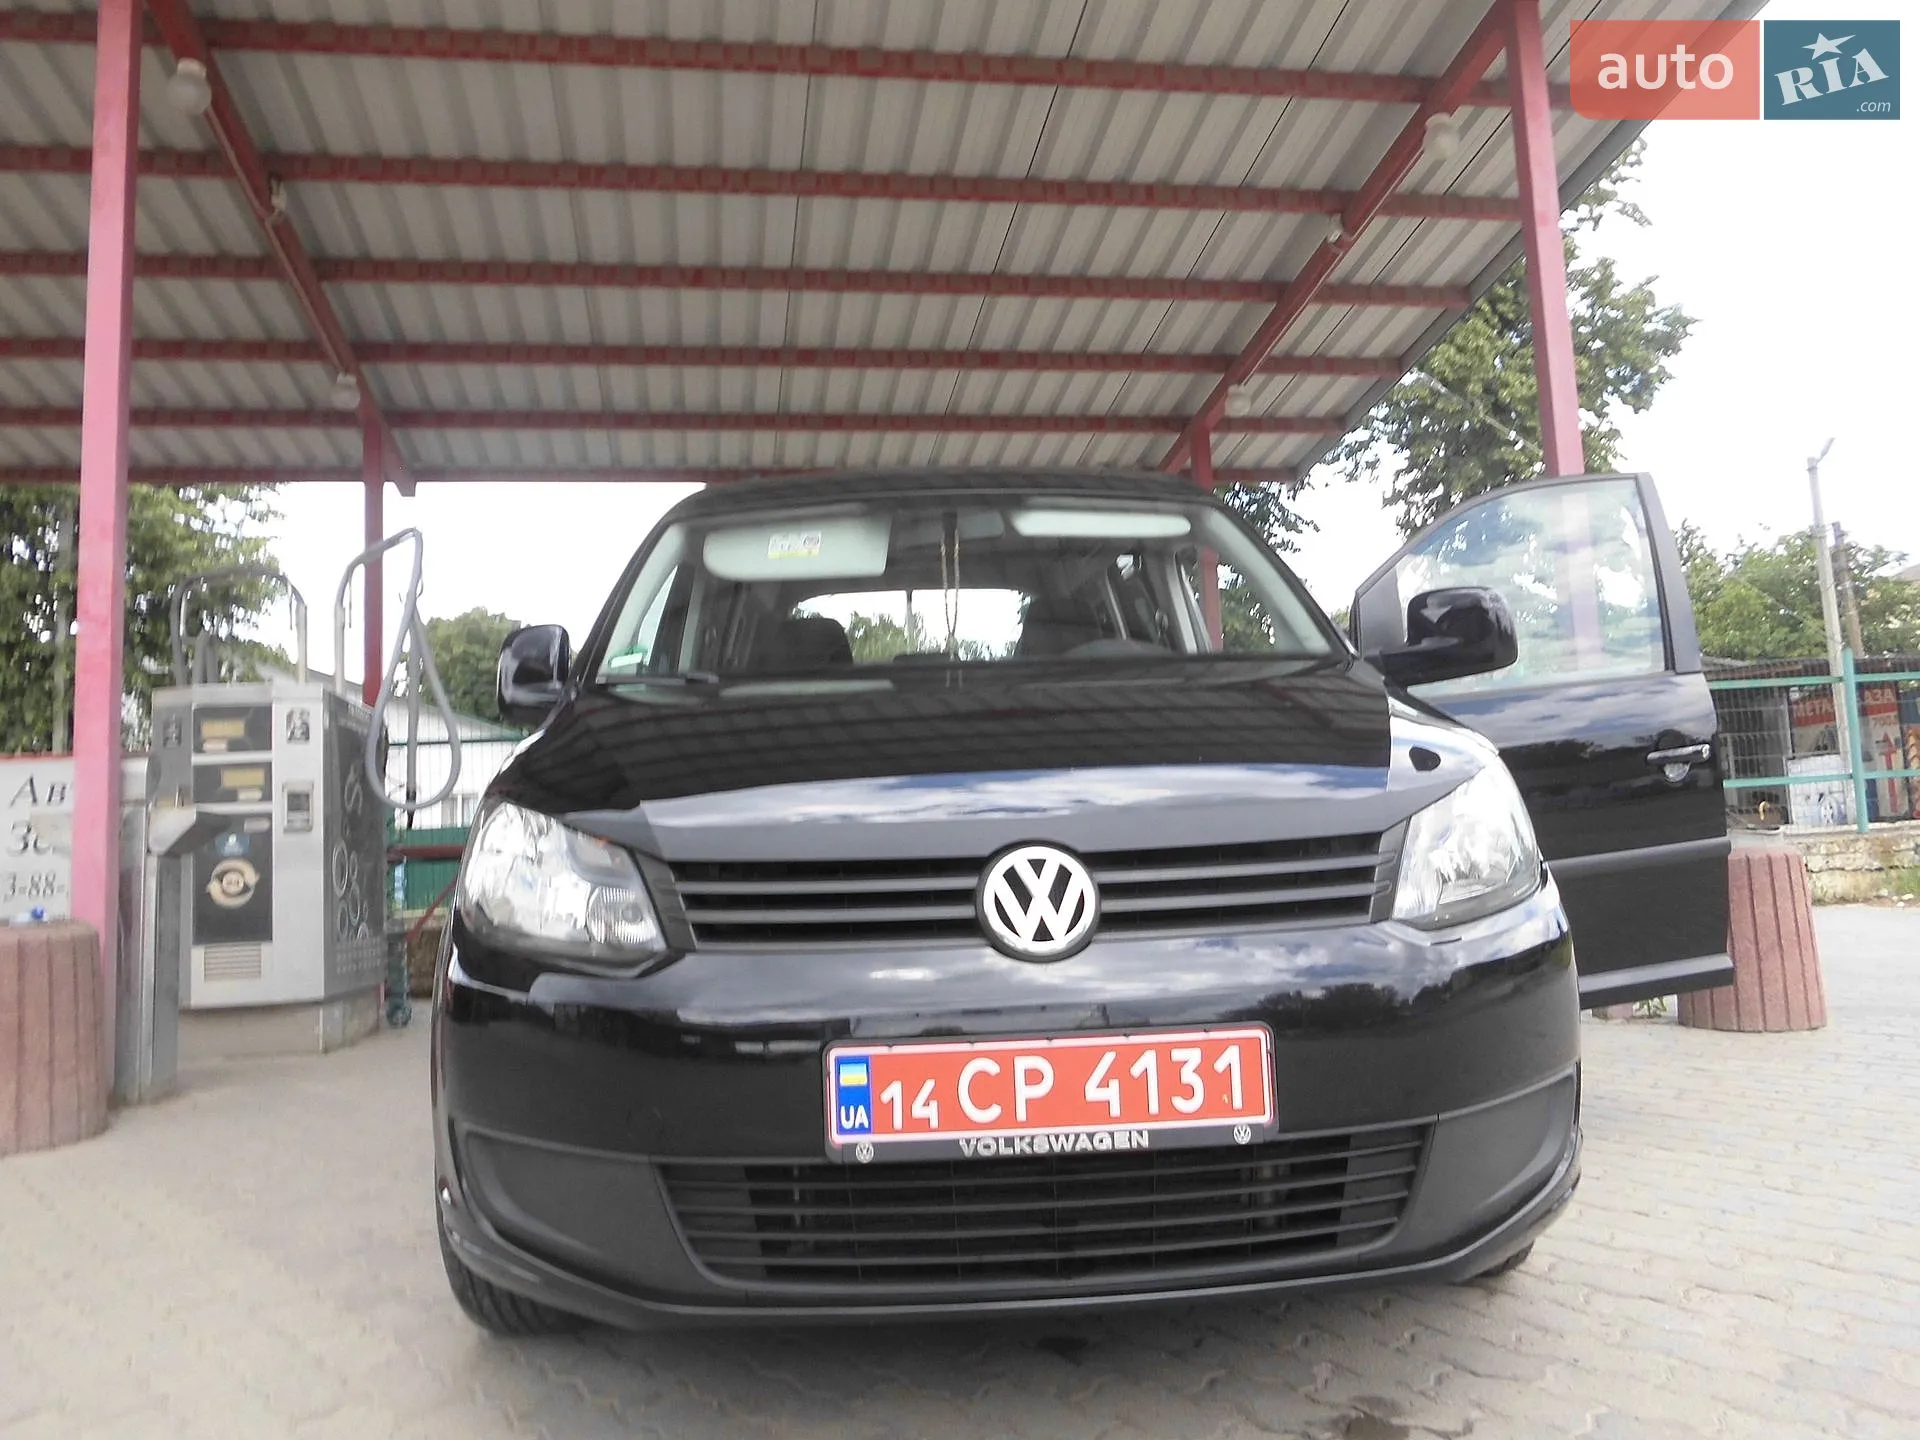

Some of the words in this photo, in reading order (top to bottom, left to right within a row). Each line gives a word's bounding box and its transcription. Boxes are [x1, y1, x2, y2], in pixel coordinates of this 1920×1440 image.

[880, 1078, 940, 1131] 14
[957, 1055, 1055, 1123] CP
[1083, 1044, 1244, 1118] 4131
[840, 1104, 869, 1130] UA
[959, 1129, 1149, 1158] VOLKSWAGEN
